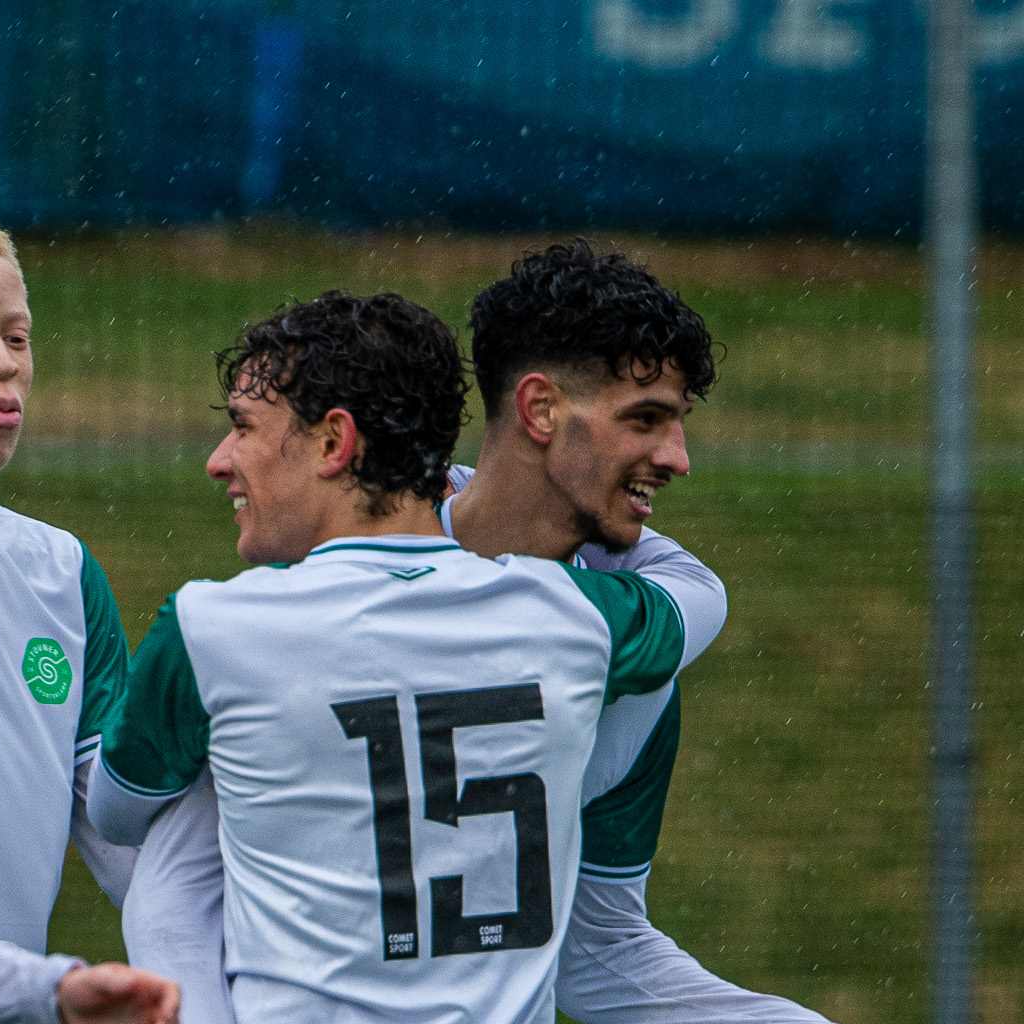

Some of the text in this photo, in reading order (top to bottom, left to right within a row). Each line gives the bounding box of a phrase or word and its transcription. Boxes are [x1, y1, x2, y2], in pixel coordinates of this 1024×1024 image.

[330, 682, 554, 961] 15
[479, 924, 503, 936] COMET
[388, 932, 414, 944] COMET
[480, 934, 502, 946] SPORT
[388, 942, 414, 954] SPORT
